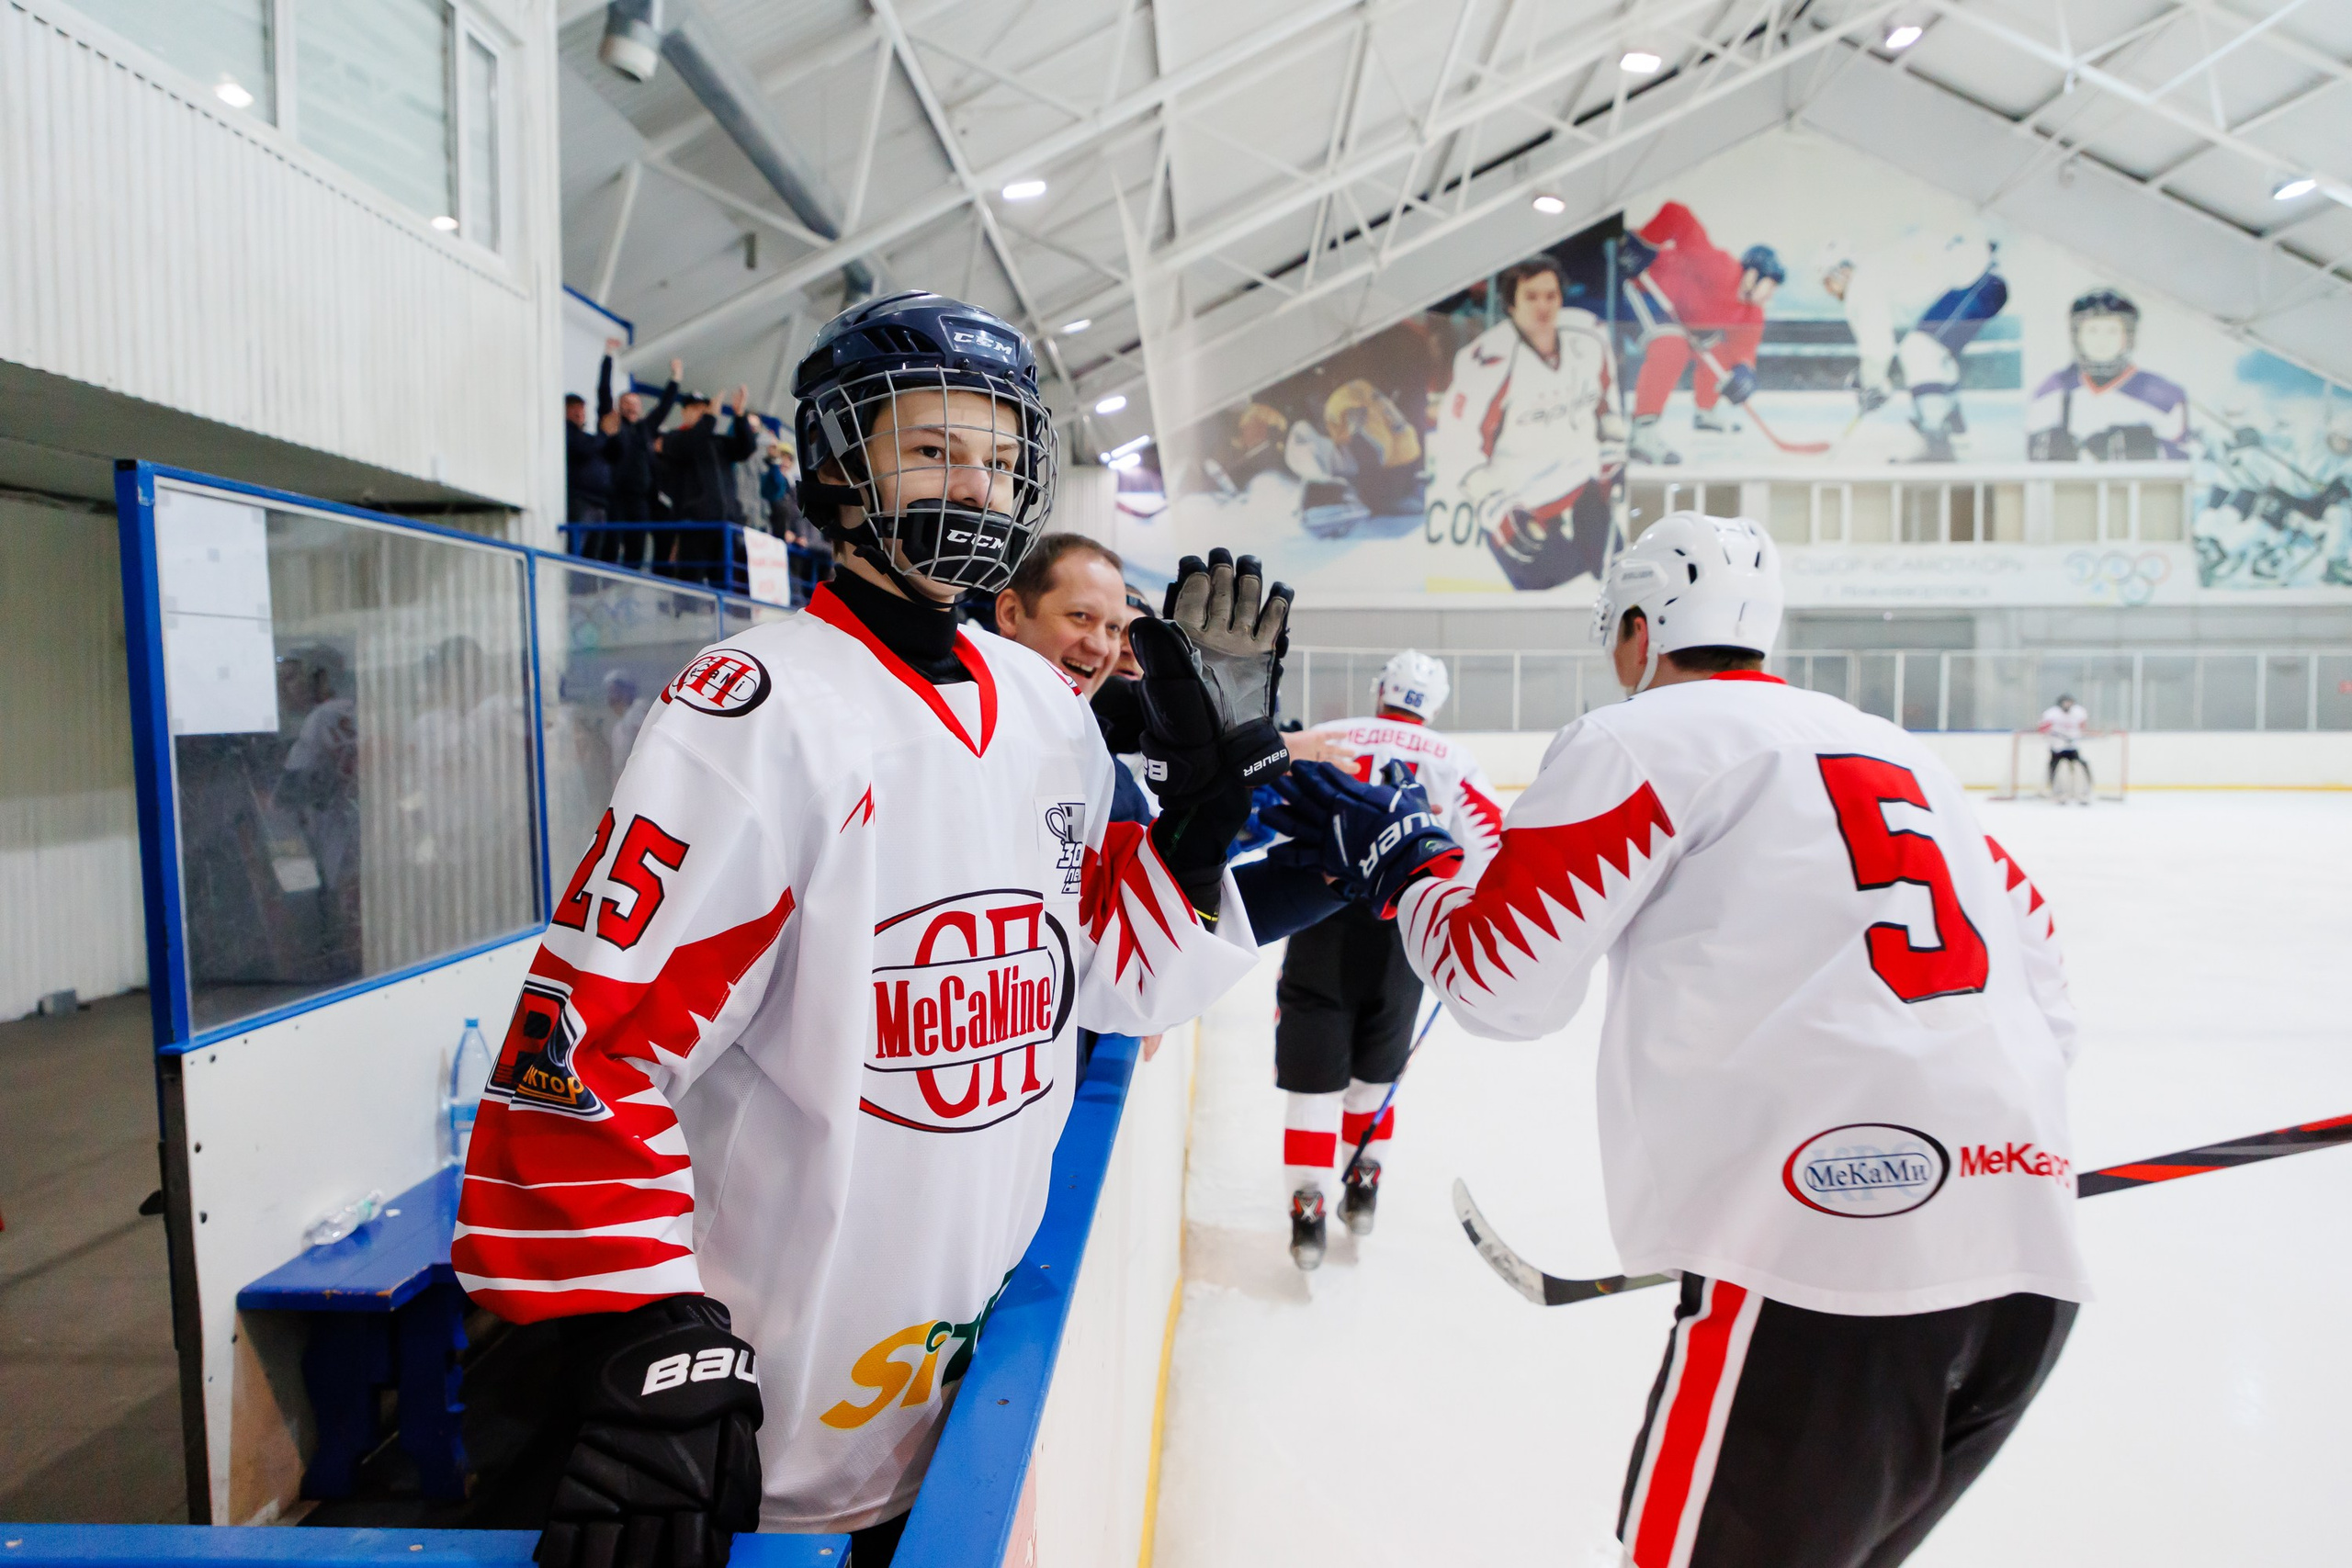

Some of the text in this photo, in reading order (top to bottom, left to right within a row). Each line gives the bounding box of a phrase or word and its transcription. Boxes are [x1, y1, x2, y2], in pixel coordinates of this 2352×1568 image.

[954, 332, 1012, 355] CCM
[946, 529, 1006, 551] CCM
[1425, 501, 1487, 547] CO
[1359, 812, 1440, 879] UER
[1815, 753, 1989, 1004] 5
[551, 807, 690, 952] 25
[873, 964, 1052, 1059] MeCaMine
